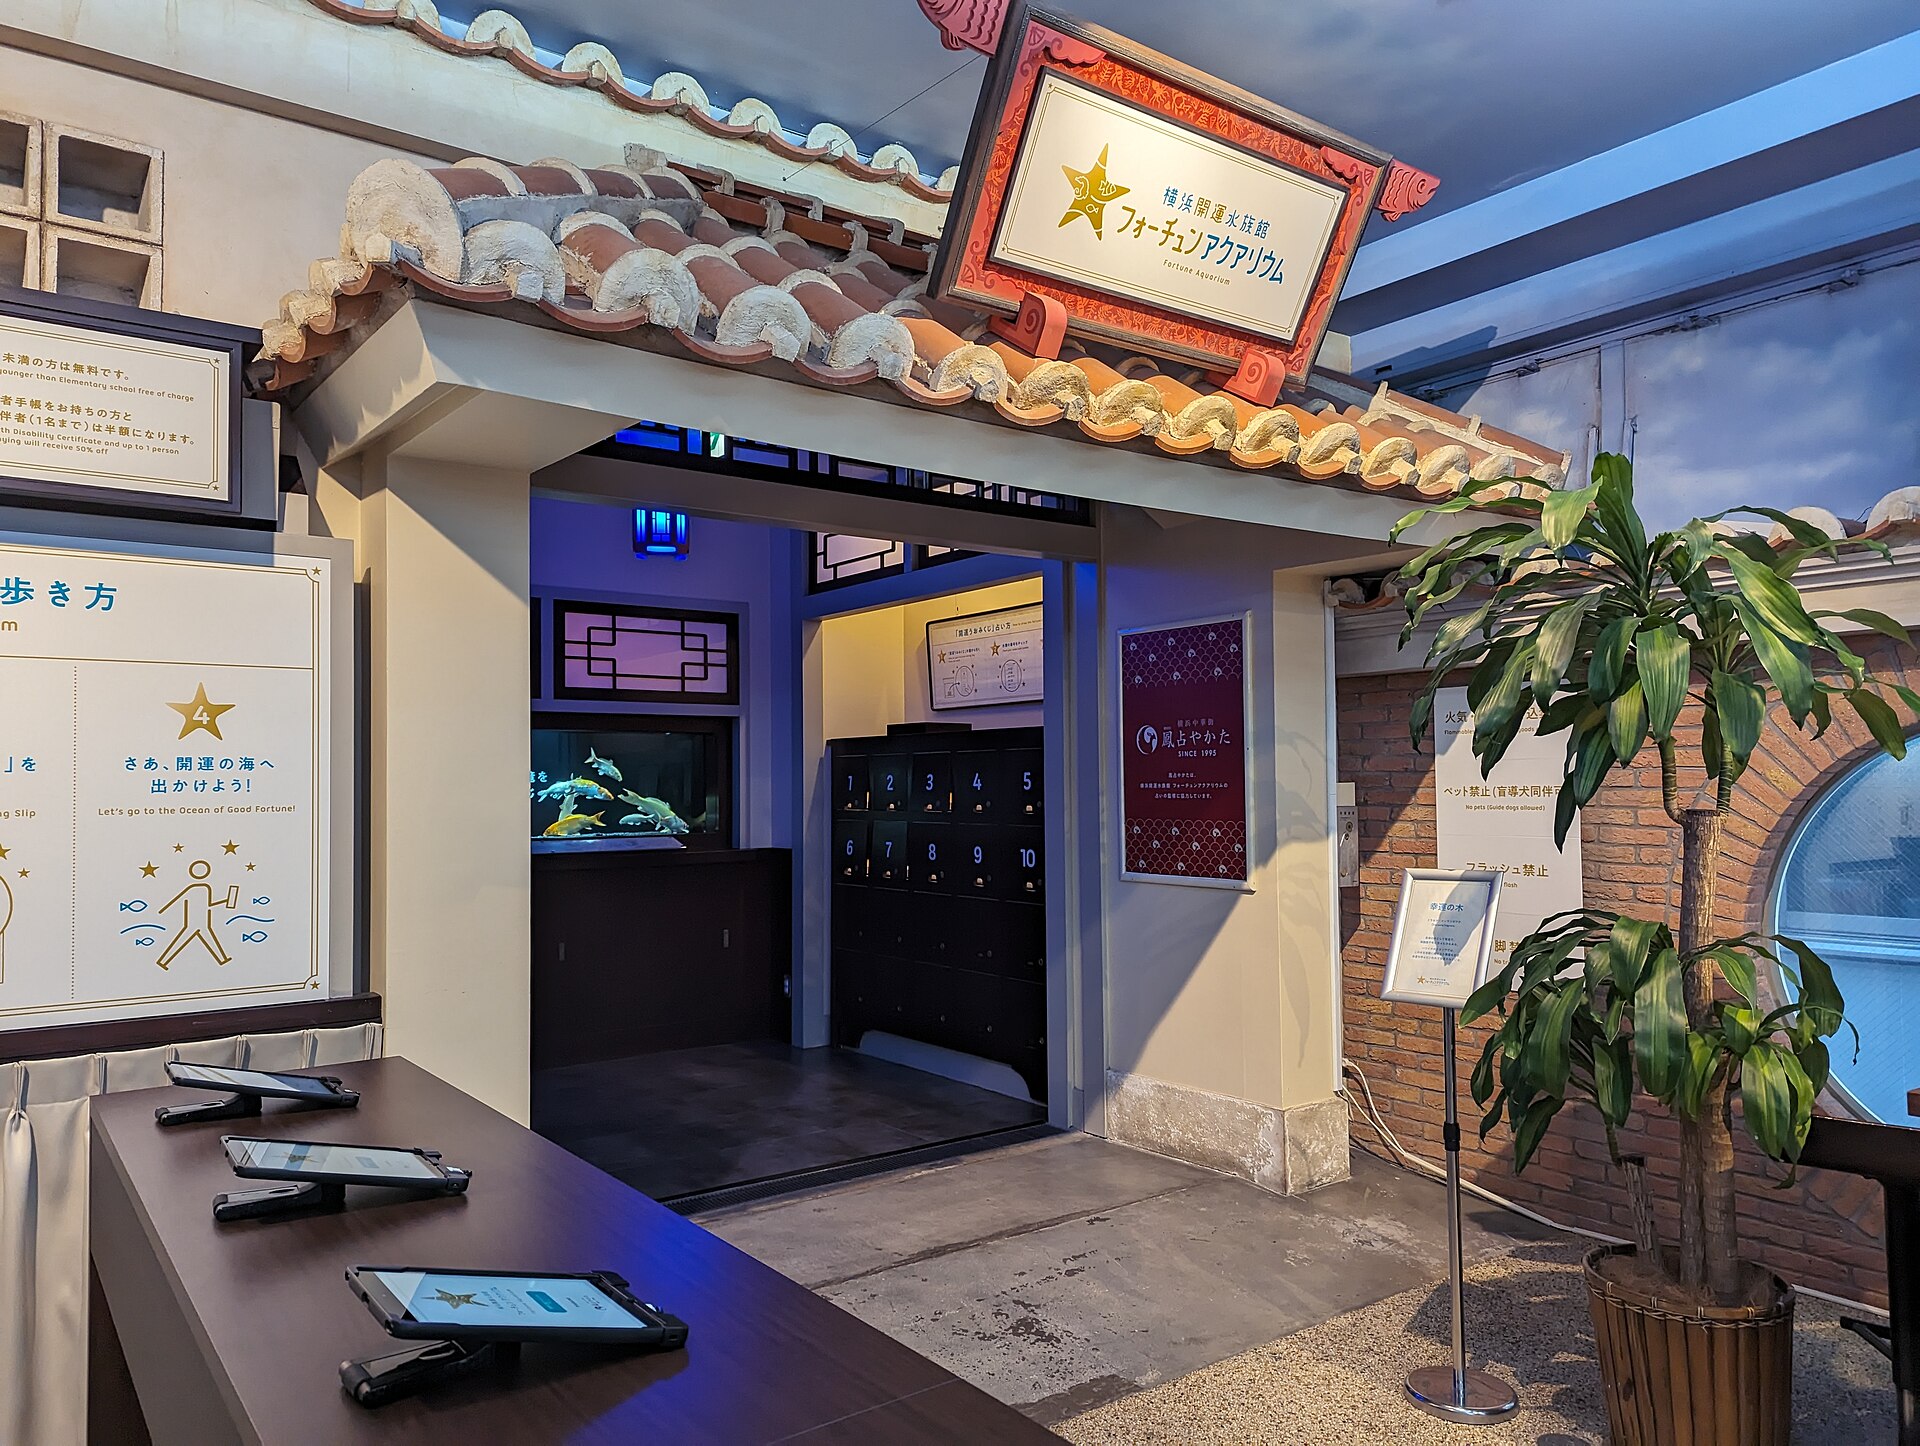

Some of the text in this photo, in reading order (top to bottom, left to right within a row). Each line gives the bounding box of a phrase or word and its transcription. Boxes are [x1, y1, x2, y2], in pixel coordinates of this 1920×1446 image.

[1163, 185, 1271, 240] 横浜開運水族館
[1116, 205, 1285, 285] フォーチュンアクアリウム
[1163, 259, 1231, 286] Fortune Aquarium
[2, 352, 129, 381] 未満の方は無料です。
[0, 368, 34, 379] ounger
[36, 372, 57, 382] than
[59, 376, 108, 391] Elementary
[109, 383, 136, 393] school
[138, 387, 155, 396] free
[167, 393, 195, 402] charge
[0, 394, 132, 422] 者手帳をお持ちの方と
[0, 437, 22, 446] ying
[24, 439, 40, 447] will
[42, 442, 74, 451] receive
[76, 445, 93, 453] 50%
[13, 428, 55, 441] Disability
[56, 433, 102, 446] Certificate
[104, 440, 120, 448] and
[122, 442, 133, 451] up
[135, 443, 144, 451] to
[152, 446, 179, 455] person
[0, 576, 118, 612] 歩き方
[192, 705, 210, 725] 4
[1161, 729, 1231, 748] 鳳占やかた
[1201, 749, 1217, 757] 1995
[124, 756, 275, 772] さあ、開運の海へ
[151, 778, 251, 794] 出かけよう!
[847, 775, 853, 791] 1
[886, 774, 894, 791] 2
[926, 773, 934, 791] 3
[972, 772, 982, 790] 4
[1023, 771, 1032, 790] 5
[14, 809, 36, 819] Slip
[98, 805, 296, 817] Let's go to the Ocean of Good Fortune!
[1474, 804, 1486, 812] pets
[1486, 804, 1505, 812] (Guide
[846, 839, 854, 856] 6
[885, 841, 893, 858] 7
[928, 843, 936, 861] 8
[973, 845, 982, 864] 9
[1020, 848, 1036, 868] 10
